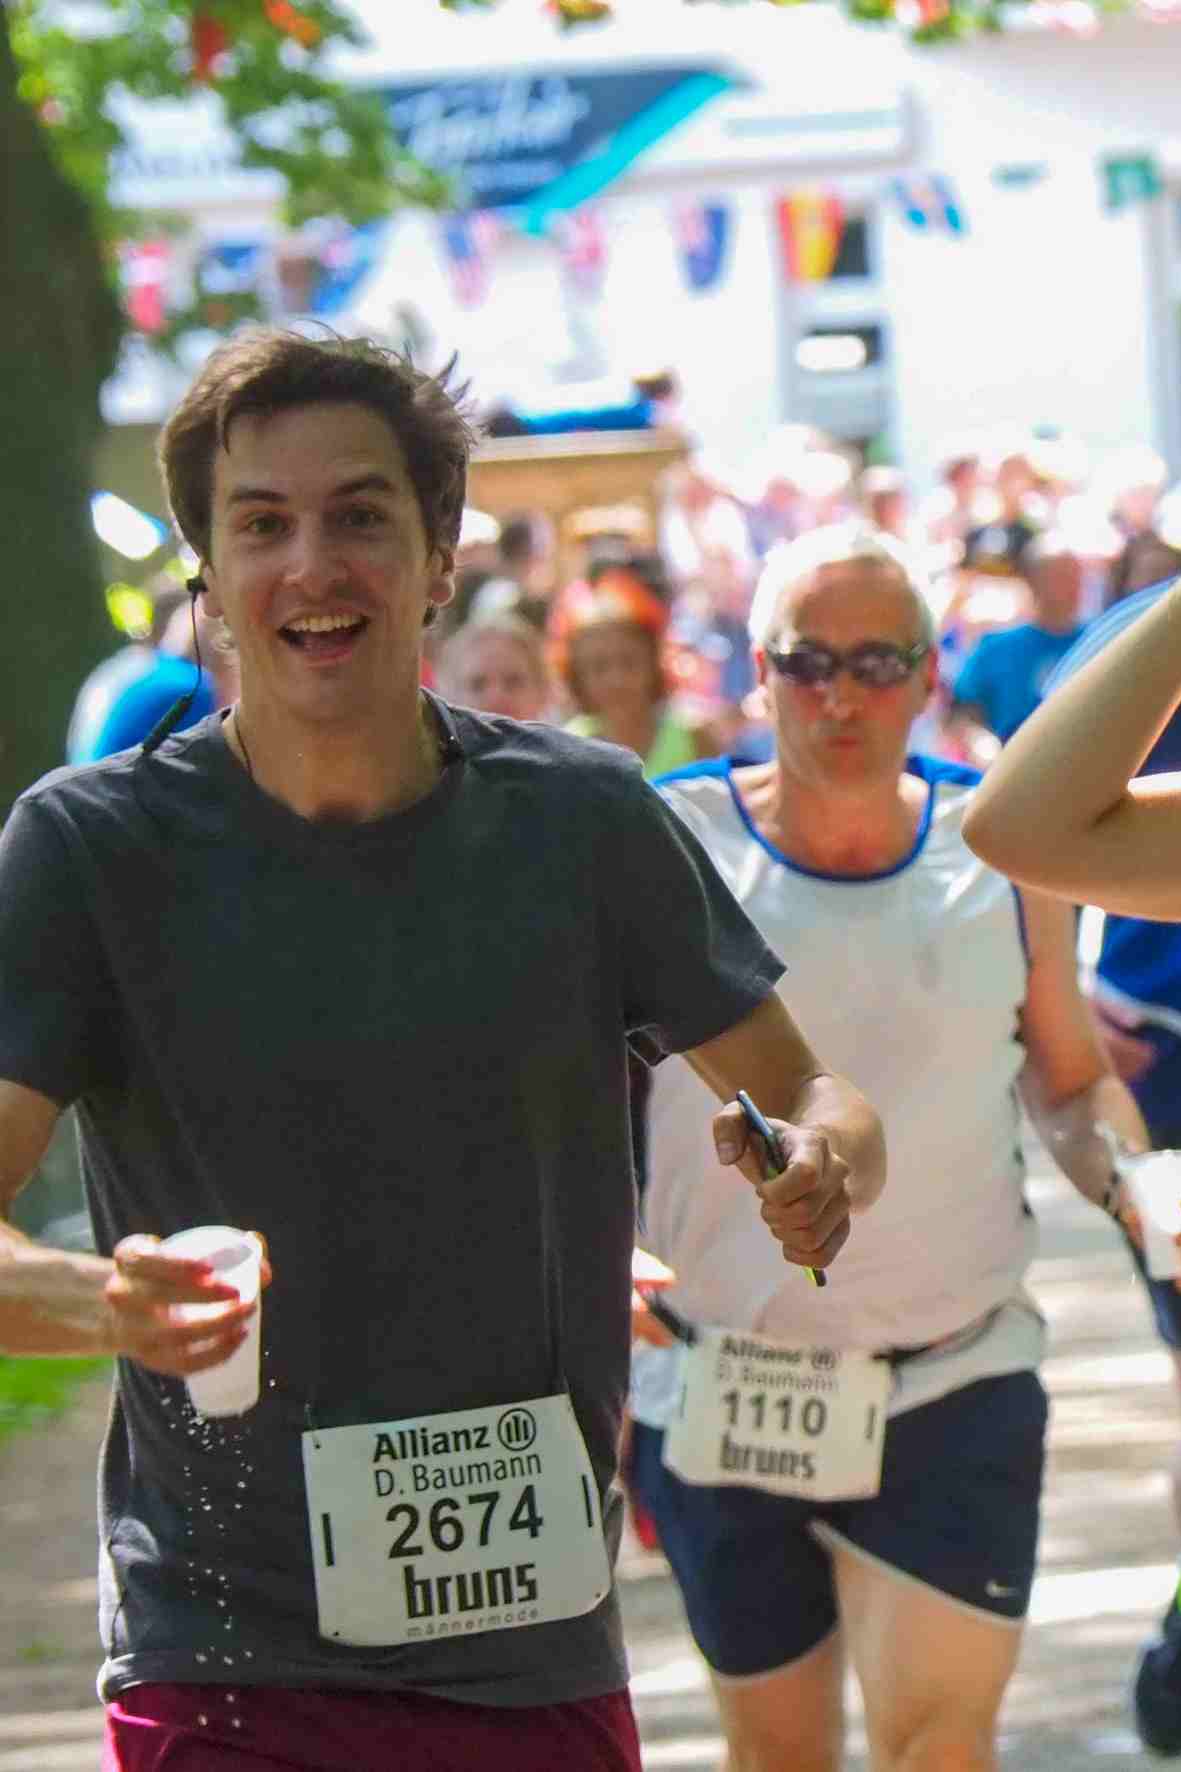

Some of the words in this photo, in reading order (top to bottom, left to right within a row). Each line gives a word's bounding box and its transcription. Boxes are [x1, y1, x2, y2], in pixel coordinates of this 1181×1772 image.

[723, 1389, 827, 1436] 1110
[372, 1425, 490, 1463] Allianz
[720, 1433, 816, 1480] bruns
[374, 1468, 404, 1497] D.
[412, 1453, 542, 1492] Baumann
[385, 1484, 544, 1559] 2674
[403, 1563, 538, 1618] bruns
